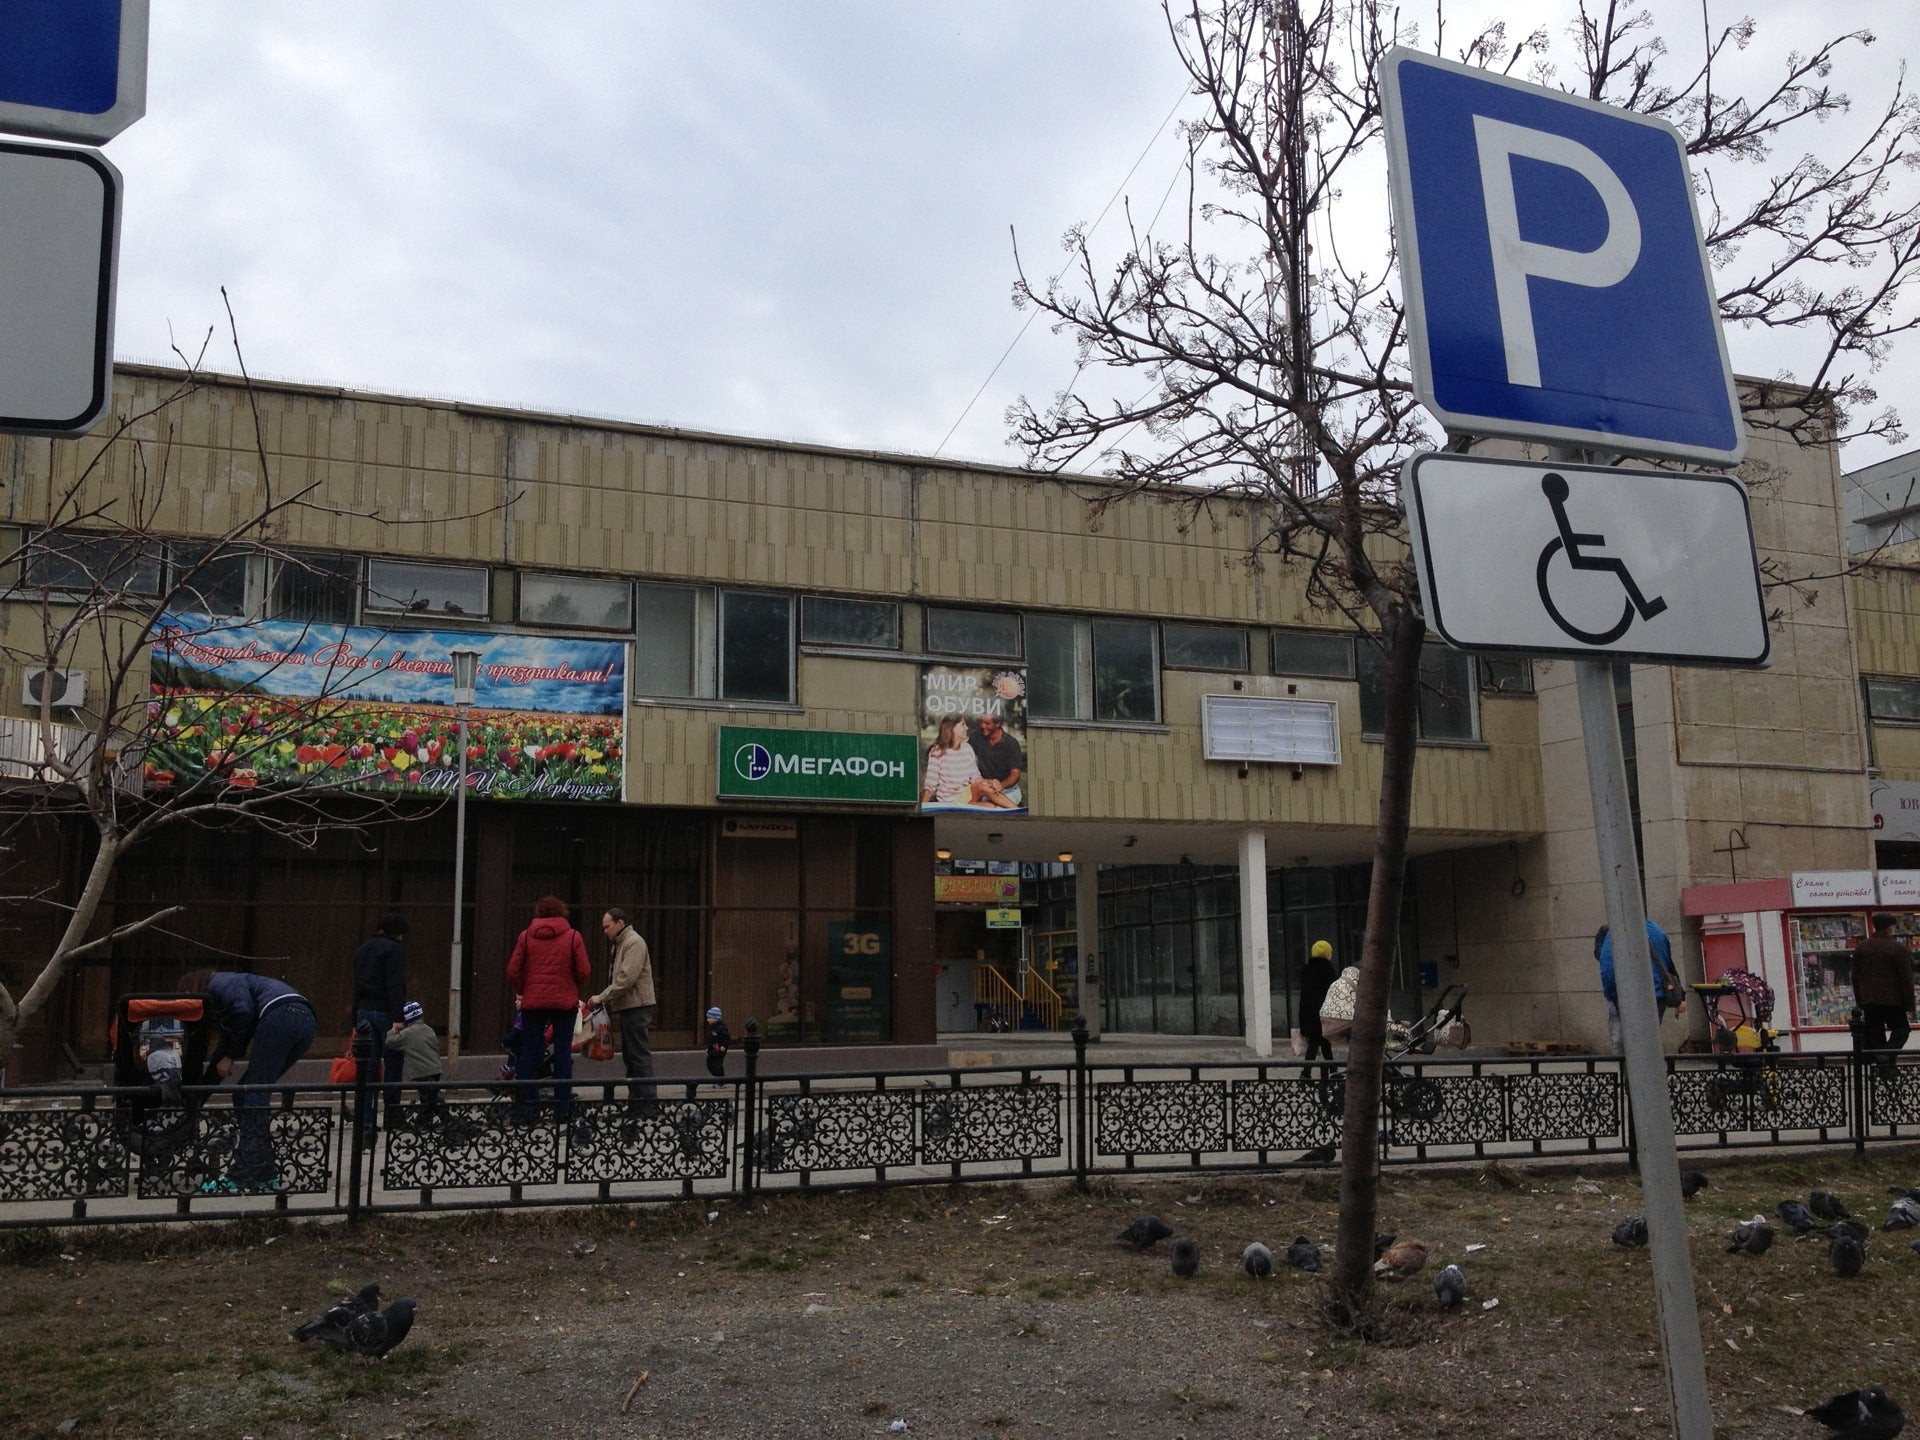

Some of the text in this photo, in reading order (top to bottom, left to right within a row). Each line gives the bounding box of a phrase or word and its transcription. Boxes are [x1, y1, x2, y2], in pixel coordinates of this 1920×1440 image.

[1472, 114, 1642, 388] P
[152, 627, 614, 684] Поздравляем Вас с весенни праздниками!
[926, 673, 977, 691] МИР
[925, 695, 1001, 716] ОБУВИ
[498, 774, 614, 800] «Меркурий»
[1796, 878, 1803, 888] С
[1882, 876, 1889, 887] С
[1835, 888, 1872, 899] детства!
[843, 932, 880, 956] 3G
